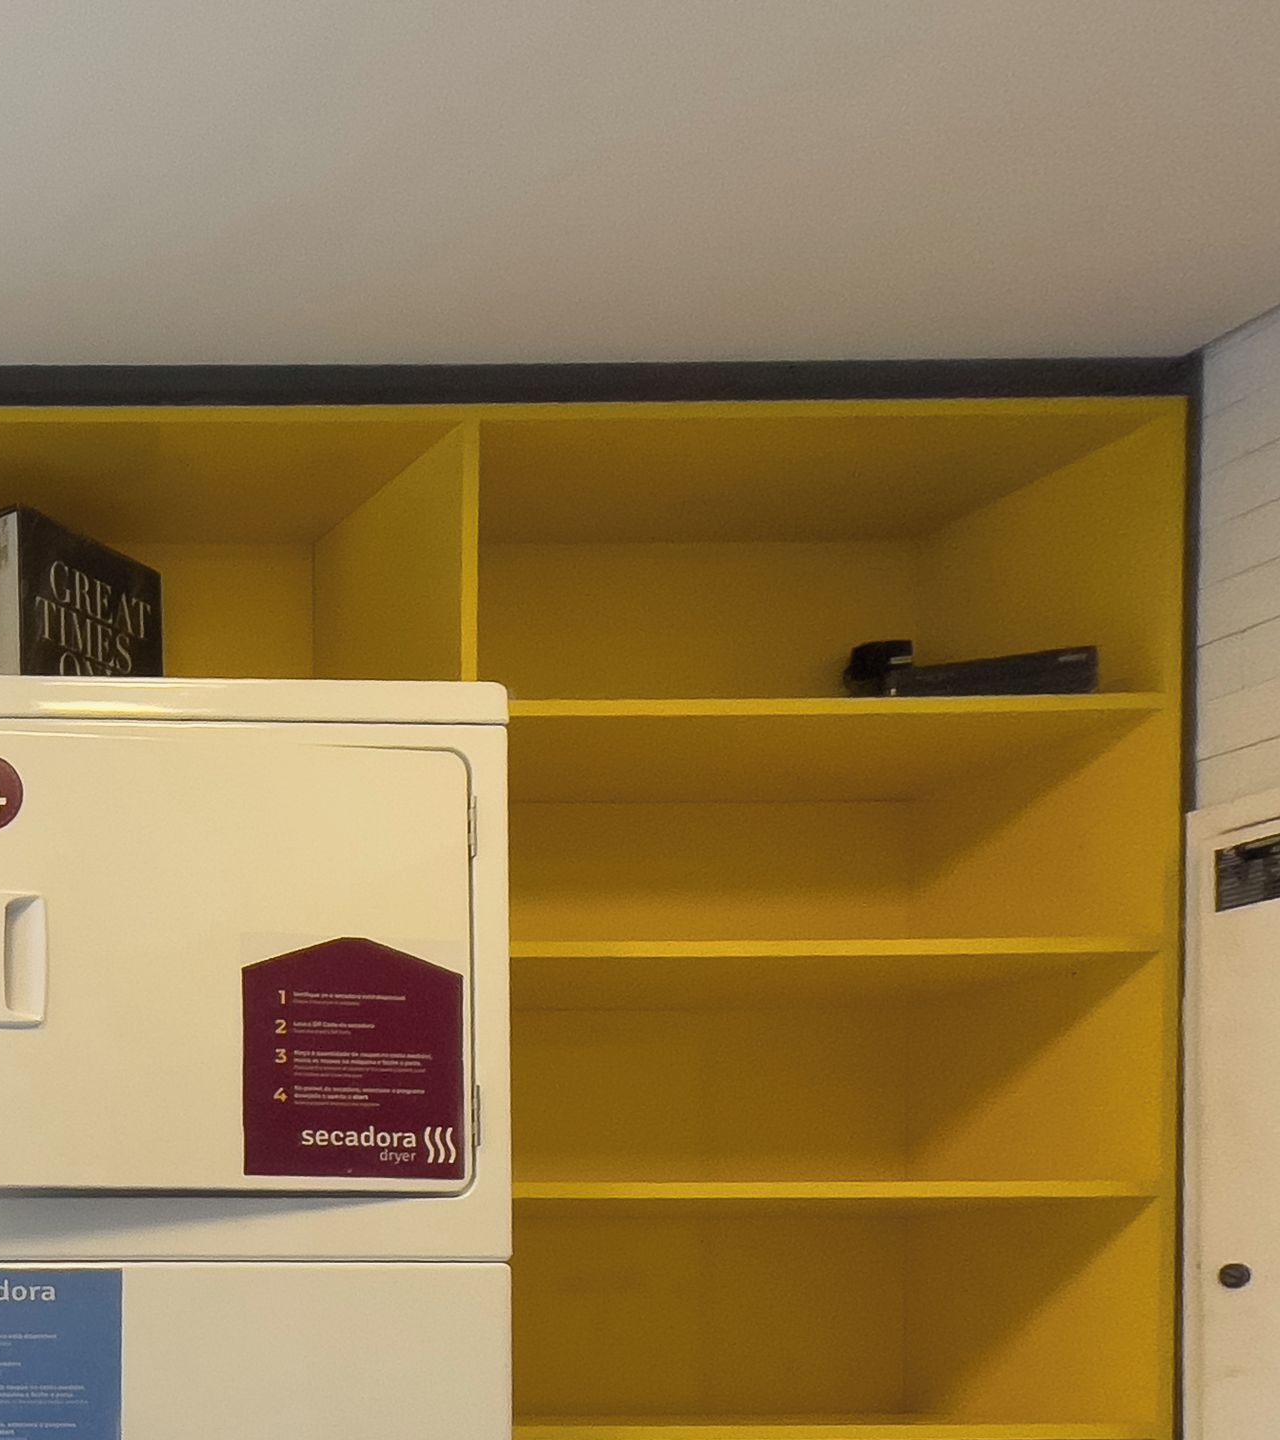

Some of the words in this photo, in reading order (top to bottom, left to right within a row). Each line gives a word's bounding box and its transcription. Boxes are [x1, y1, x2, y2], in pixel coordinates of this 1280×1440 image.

[49, 560, 152, 639] GREAT
[35, 596, 133, 674] TIMES
[278, 990, 286, 1004] 1
[274, 1020, 287, 1033] 2
[274, 1049, 287, 1063] 3
[273, 1087, 288, 1102] 4
[301, 1126, 416, 1148] secadora
[379, 1149, 416, 1164] dryer
